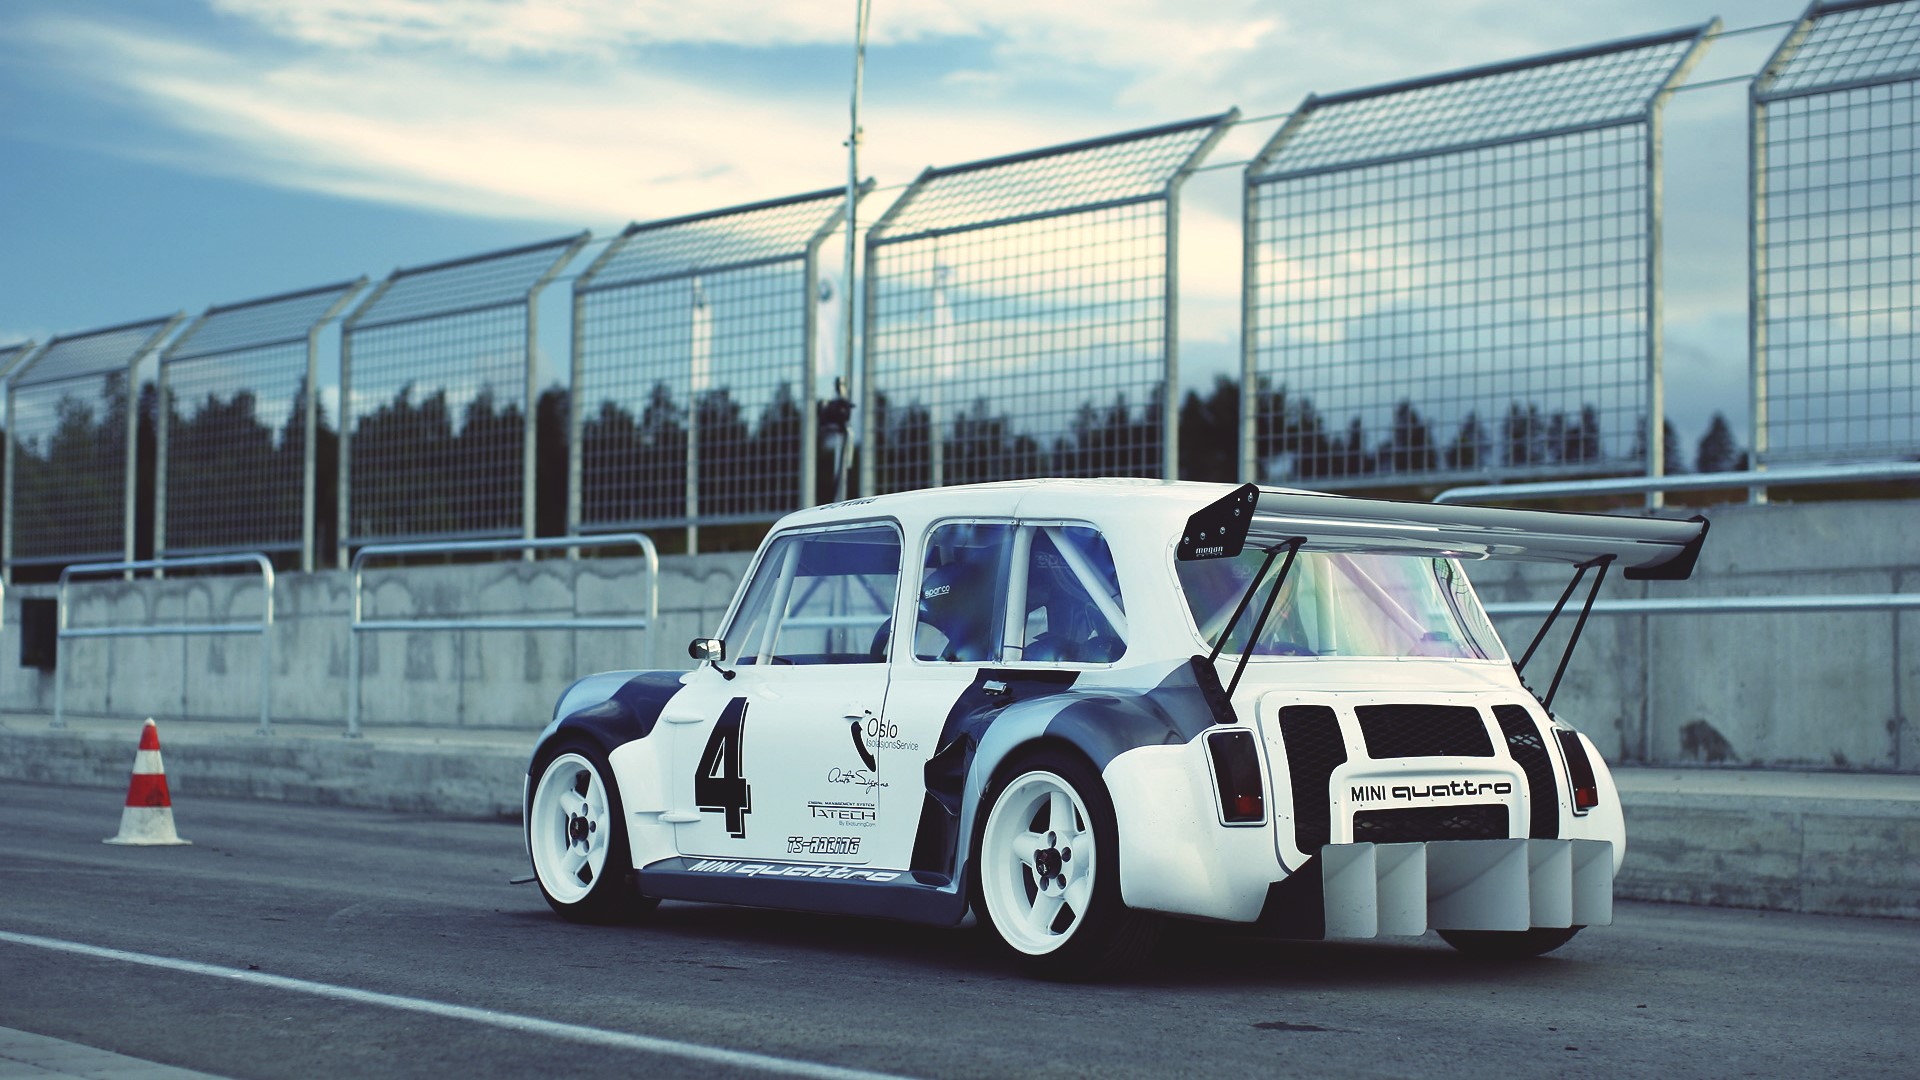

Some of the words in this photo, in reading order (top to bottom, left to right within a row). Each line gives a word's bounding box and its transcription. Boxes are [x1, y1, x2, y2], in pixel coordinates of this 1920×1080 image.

[925, 585, 950, 598] sparco
[867, 717, 898, 738] Oslo
[695, 697, 752, 839] 4
[1351, 785, 1386, 802] MINI
[1391, 780, 1512, 801] quattro
[787, 836, 861, 854] TS-RACING
[688, 860, 742, 873] MINI
[735, 864, 902, 882] quattro
